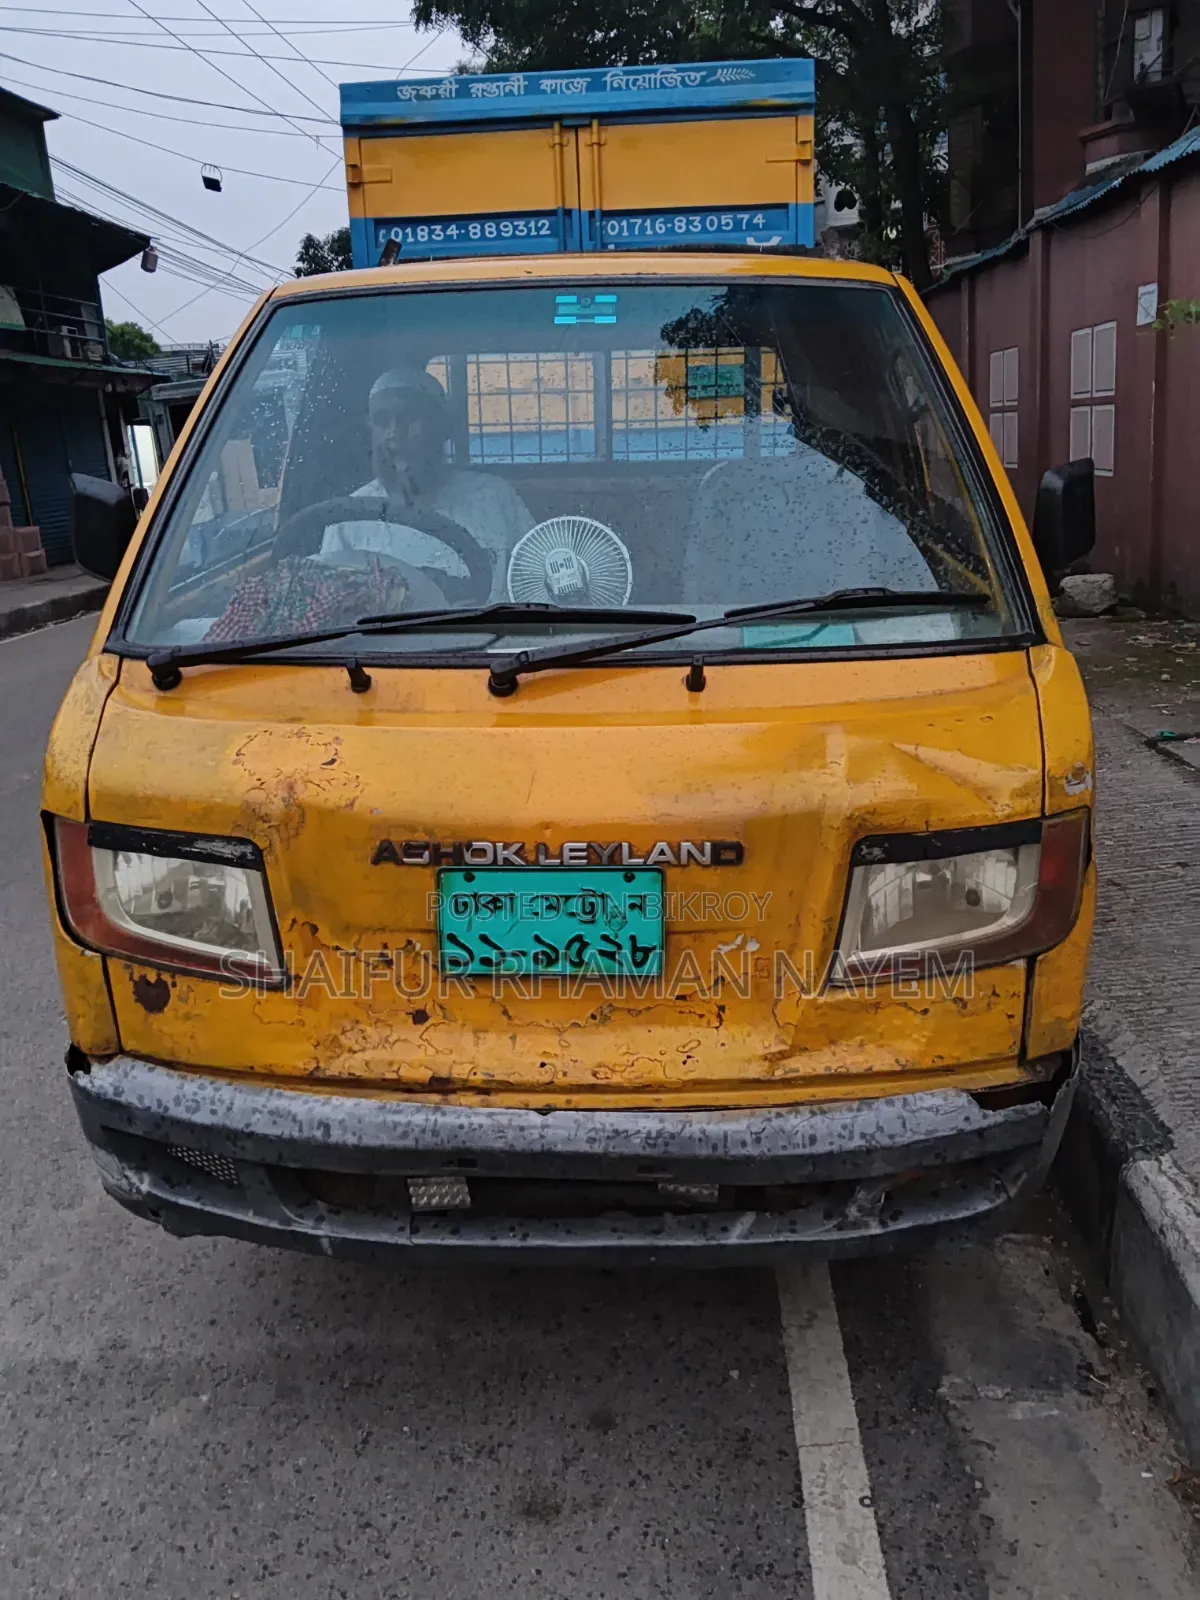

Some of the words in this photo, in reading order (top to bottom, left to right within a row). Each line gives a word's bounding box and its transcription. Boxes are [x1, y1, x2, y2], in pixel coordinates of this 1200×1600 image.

[539, 77, 592, 95] কাজে
[601, 67, 707, 92] নিয়োজিত
[607, 213, 767, 237] 01716-830574
[369, 839, 526, 867] ASHOK
[537, 840, 744, 867] LEYLAND
[451, 891, 516, 916] ঢাকা
